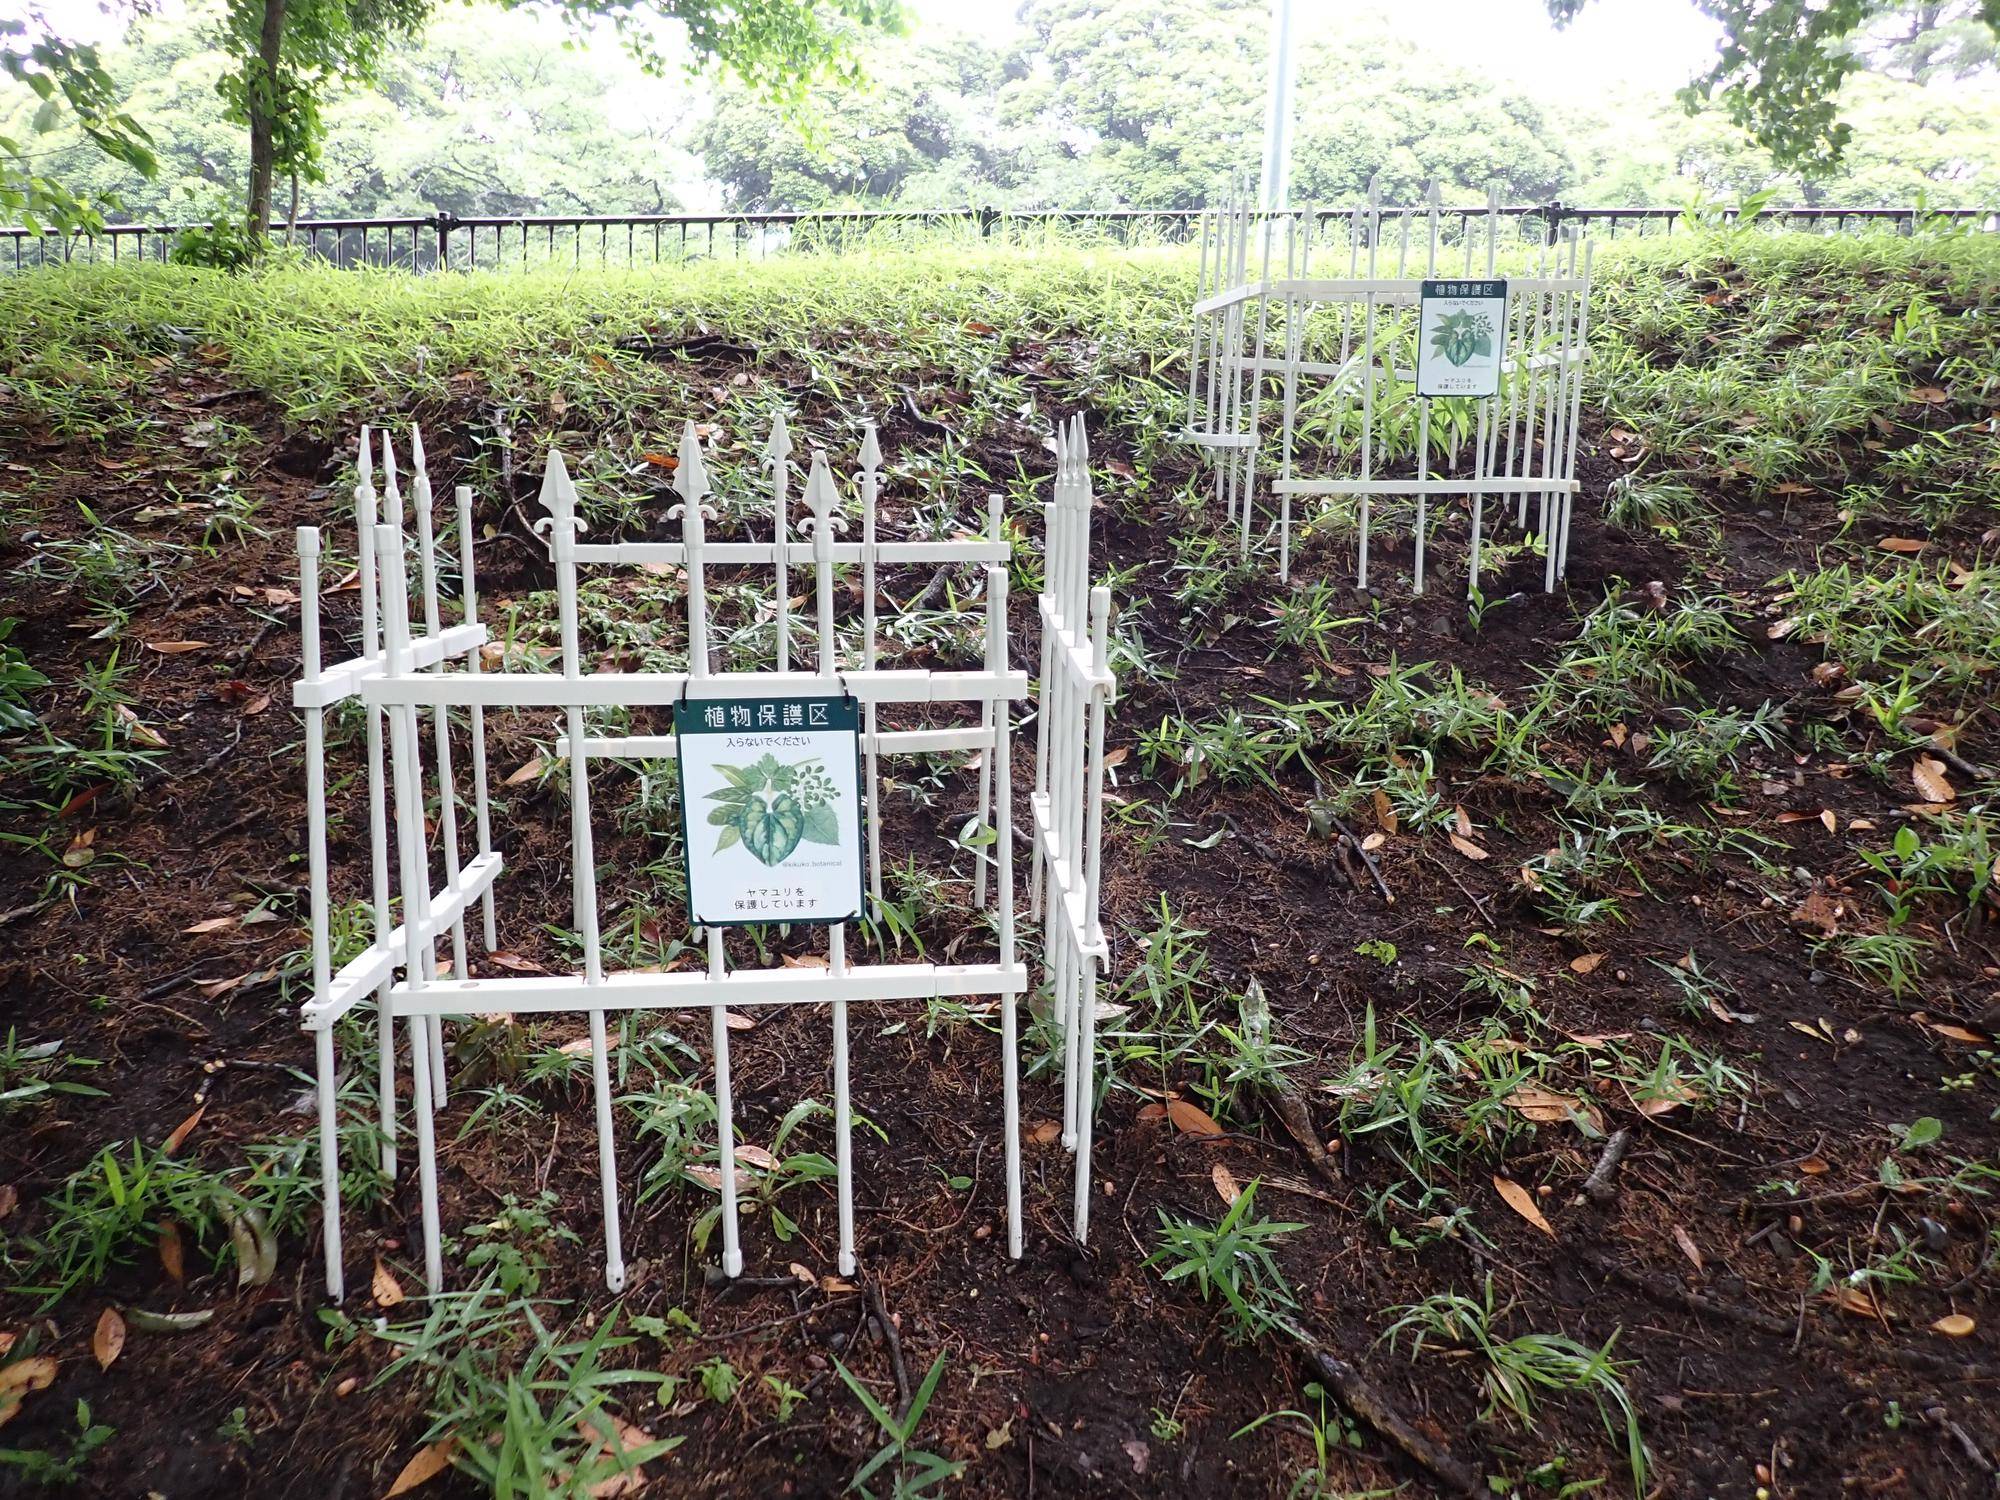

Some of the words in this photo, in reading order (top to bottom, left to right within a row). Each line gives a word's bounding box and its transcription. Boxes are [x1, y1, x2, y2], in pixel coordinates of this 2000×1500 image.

[704, 703, 829, 728] 植物保護区
[726, 736, 811, 748] 入らないでください
[746, 887, 805, 897] ヤマユリを
[734, 898, 817, 910] 保護しています
